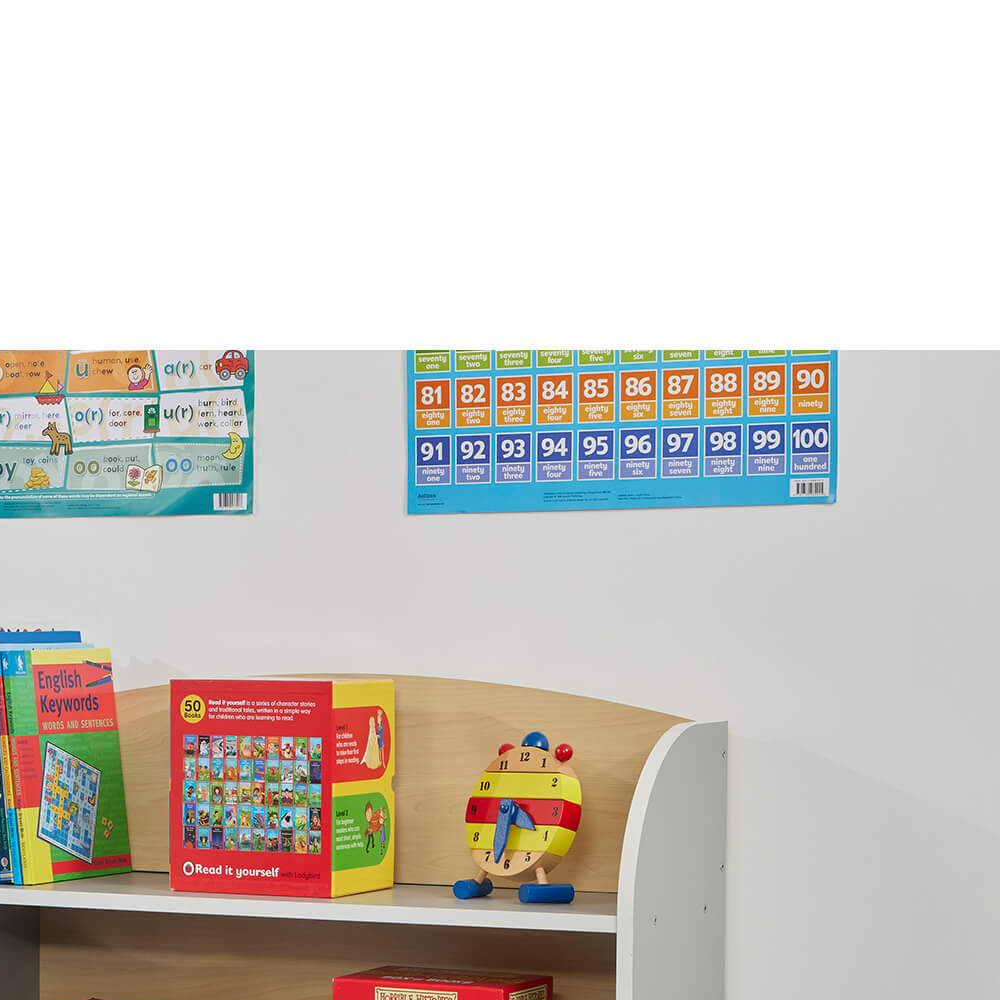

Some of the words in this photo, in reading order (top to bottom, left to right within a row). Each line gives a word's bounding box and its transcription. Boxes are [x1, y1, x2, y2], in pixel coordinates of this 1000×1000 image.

[164, 360, 194, 378] a(r)
[584, 379, 608, 398] 85
[626, 377, 652, 396] 86
[668, 375, 694, 395] 87
[711, 373, 737, 393] 88
[754, 371, 780, 391] 89
[797, 369, 824, 389] 90
[421, 386, 441, 405] 81
[461, 384, 486, 403] 82
[501, 382, 526, 401] 83
[542, 381, 568, 400] 84
[798, 400, 823, 408] ninety
[75, 408, 104, 424] o(r)
[164, 405, 193, 423] u(r)
[542, 438, 568, 457] 94
[583, 436, 608, 455] 95
[624, 435, 652, 454] 96
[667, 433, 694, 452] 97
[710, 432, 736, 451] 98
[753, 430, 780, 450] 99
[793, 428, 828, 448] 100
[421, 442, 442, 461] 91
[461, 441, 486, 460] 92
[501, 439, 525, 458] 93
[74, 461, 100, 475] oo
[38, 669, 82, 693] English
[40, 694, 99, 717] Keywords
[184, 701, 201, 712] 50
[42, 721, 64, 730] WORDS
[67, 720, 78, 729] AND
[81, 718, 114, 728] SENTENCES
[499, 760, 508, 770] 11
[520, 752, 530, 762] 12
[542, 758, 546, 768] 1
[480, 781, 490, 791] 10
[552, 778, 558, 787] 2
[552, 807, 558, 816] 3
[473, 832, 479, 842] 8
[485, 851, 491, 862] 7
[504, 860, 510, 869] 6
[525, 852, 531, 862] 5
[195, 864, 222, 875] Read
[225, 866, 232, 876] it
[236, 867, 279, 878] yourself
